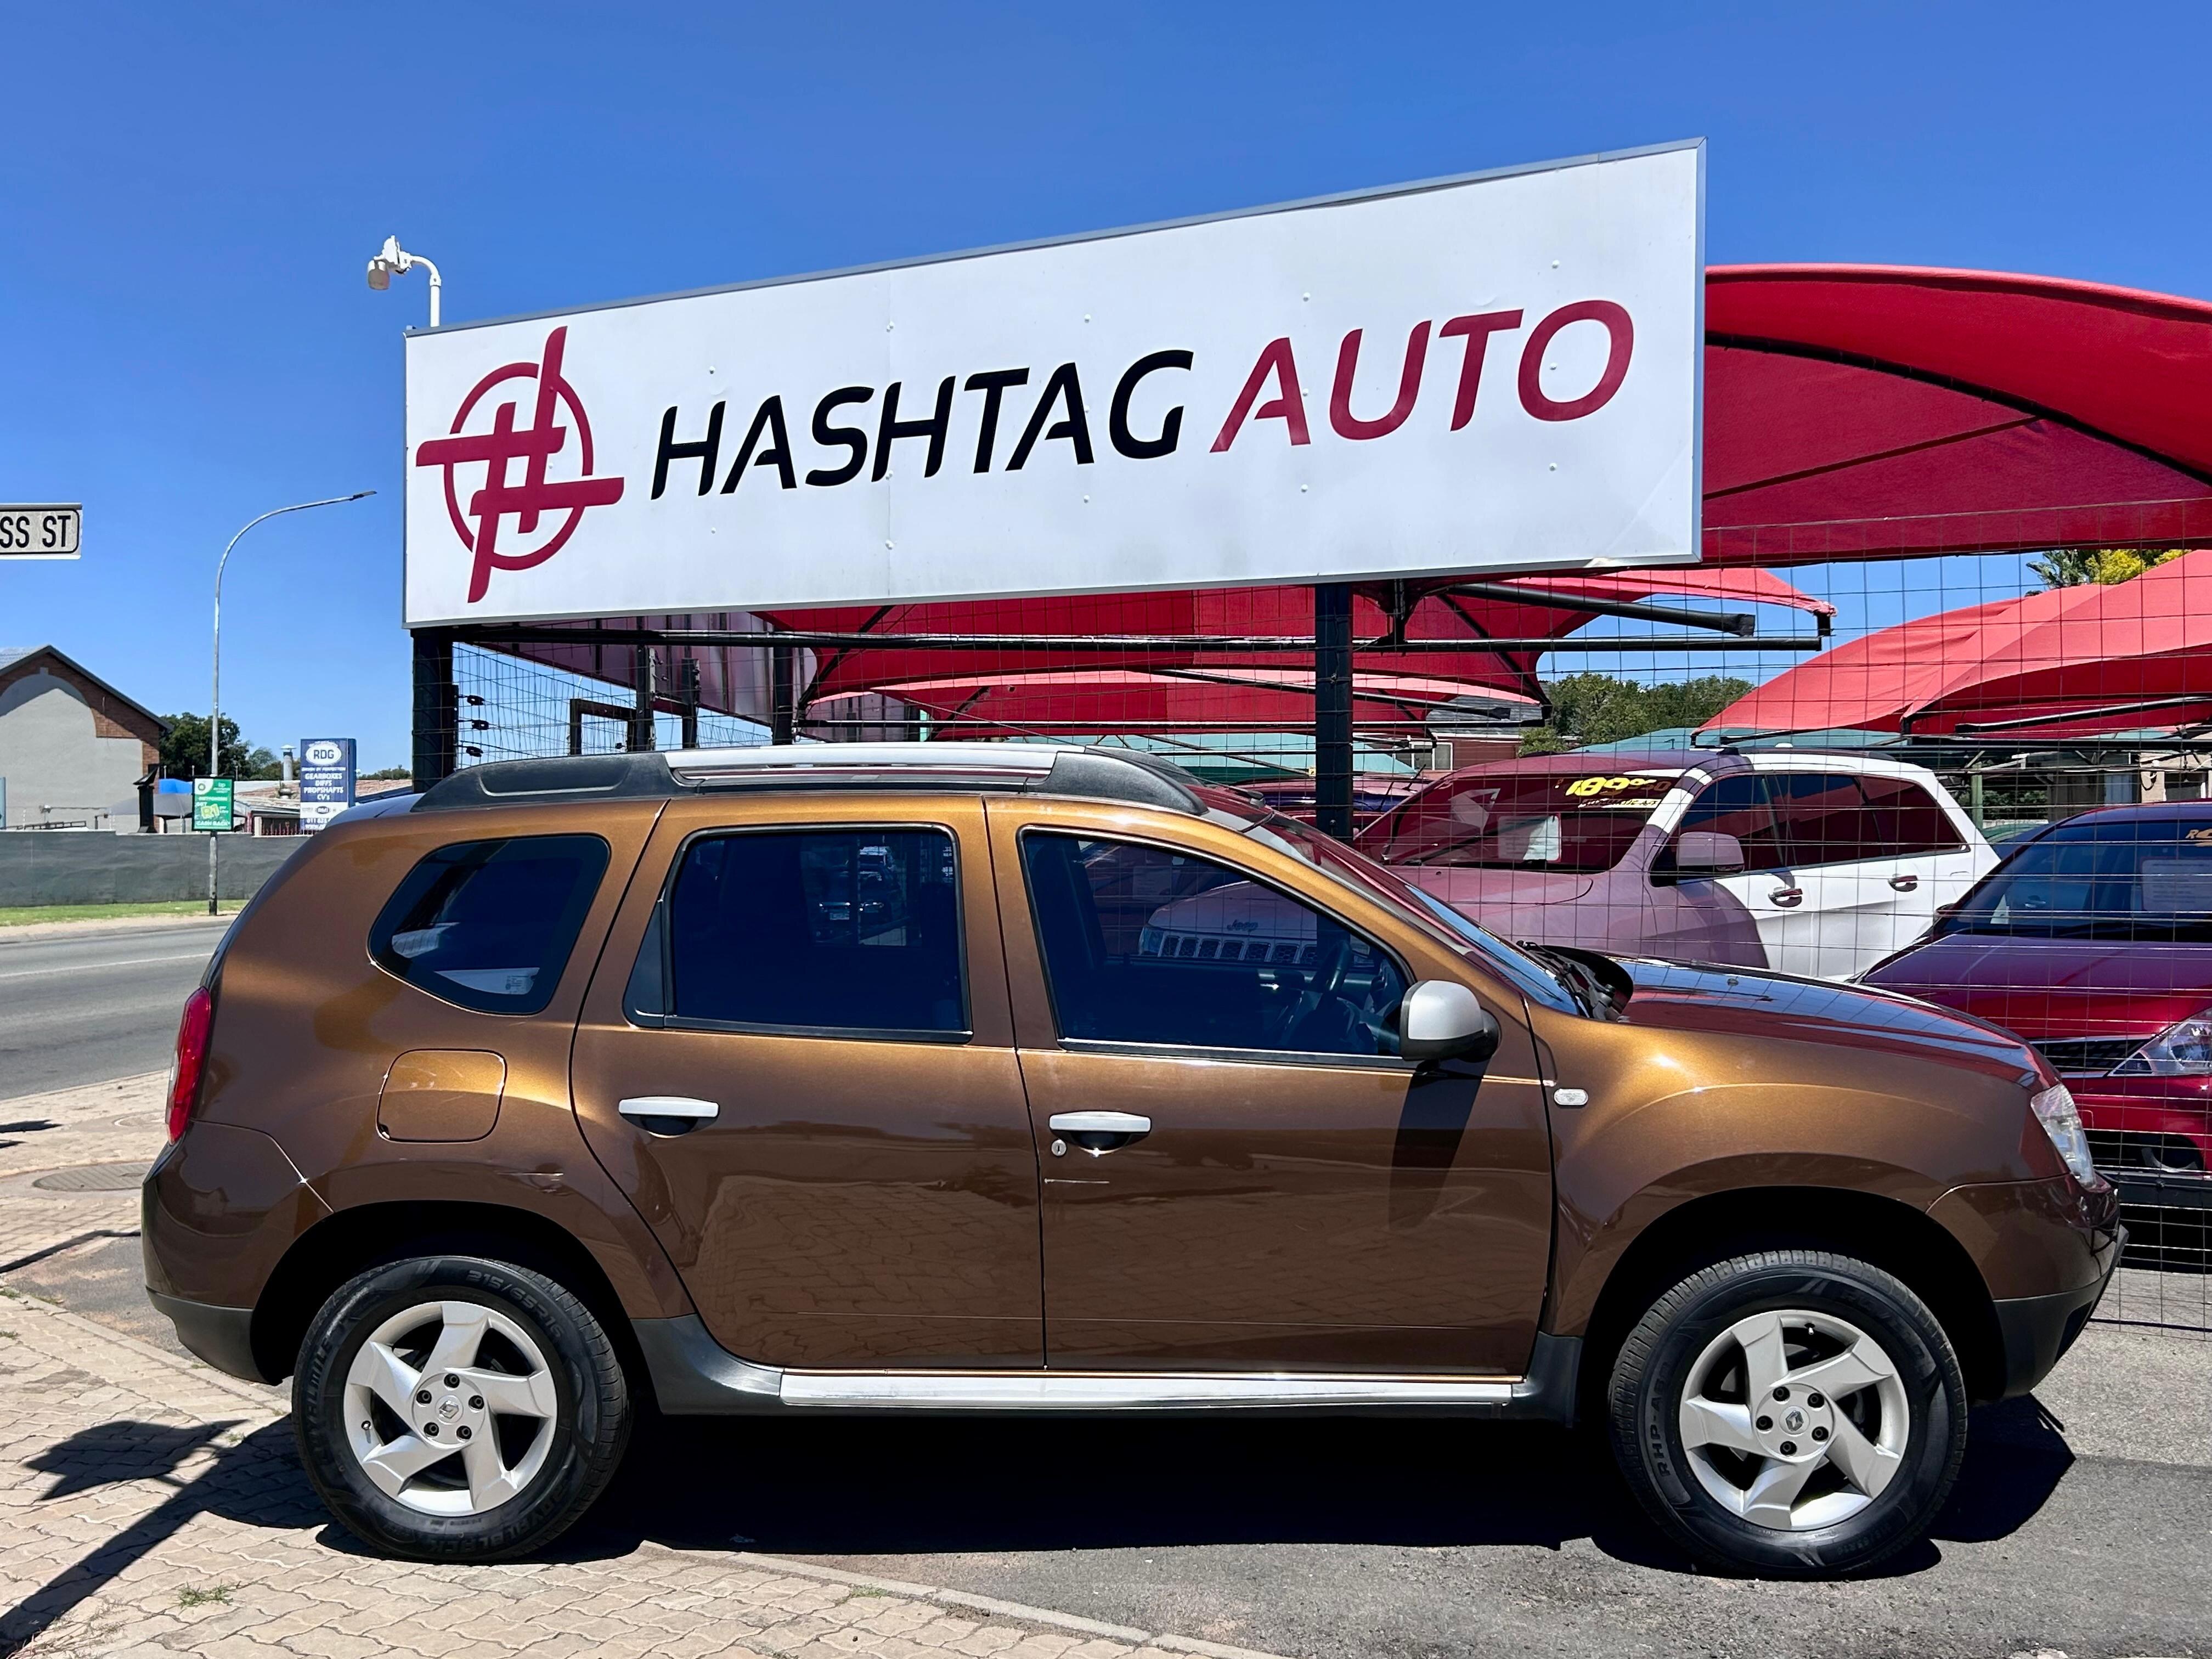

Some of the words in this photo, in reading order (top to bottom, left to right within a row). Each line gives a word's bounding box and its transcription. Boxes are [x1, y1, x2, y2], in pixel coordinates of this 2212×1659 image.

[651, 349, 1194, 500] HASHTAG
[1209, 300, 1634, 454] AUTO
[0, 516, 30, 548] SS
[42, 515, 71, 548] ST
[313, 749, 334, 759] RDG
[1227, 919, 1259, 932] Jeep
